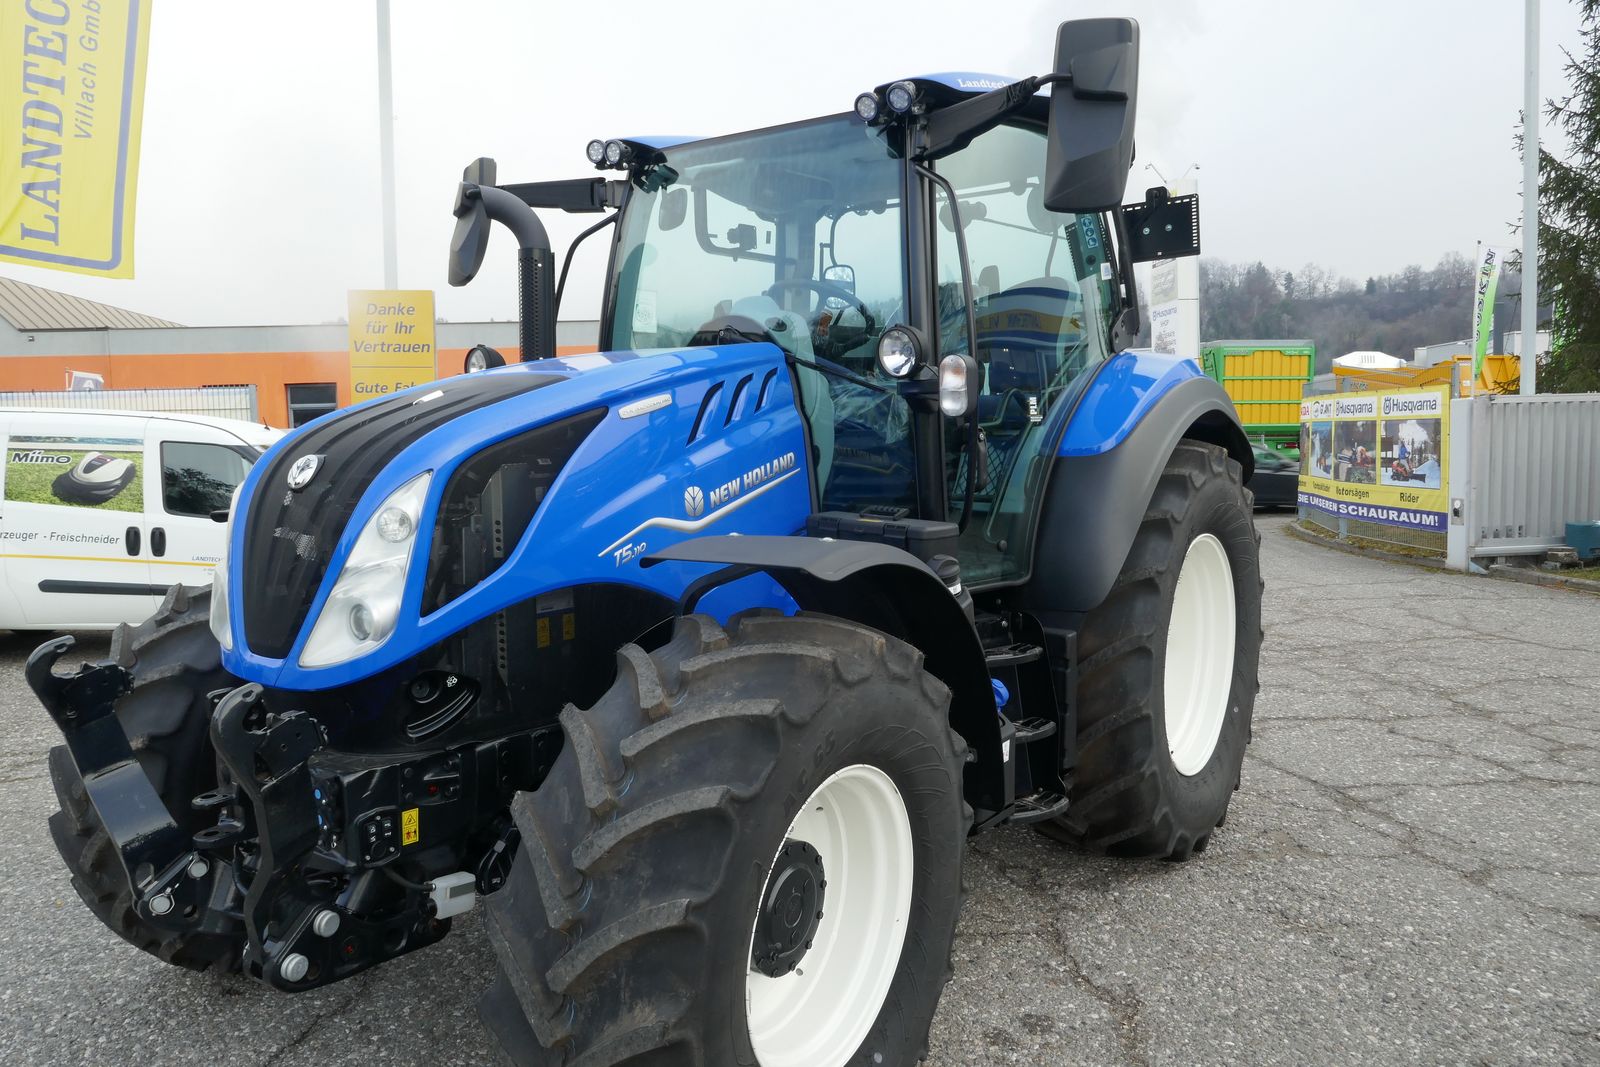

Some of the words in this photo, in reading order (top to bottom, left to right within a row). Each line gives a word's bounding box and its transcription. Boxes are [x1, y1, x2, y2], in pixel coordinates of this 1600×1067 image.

[74, 62, 97, 138] Villach
[20, 0, 70, 246] LANDTEC
[366, 303, 415, 316] Danke
[365, 321, 388, 334] für
[394, 321, 415, 334] Ihr
[354, 340, 431, 353] Vertrauen
[355, 382, 388, 393] Gute
[1340, 402, 1373, 416] Husqvarna
[1392, 398, 1437, 413] Husqvarna
[12, 450, 72, 464] Miimo
[709, 479, 741, 509] NEW
[743, 452, 796, 490] HOLLAND
[1400, 492, 1420, 503] Rider
[1310, 496, 1338, 512] UNSEREN
[1339, 504, 1438, 526] SCHAURAUM!
[50, 532, 120, 544] Freischneider
